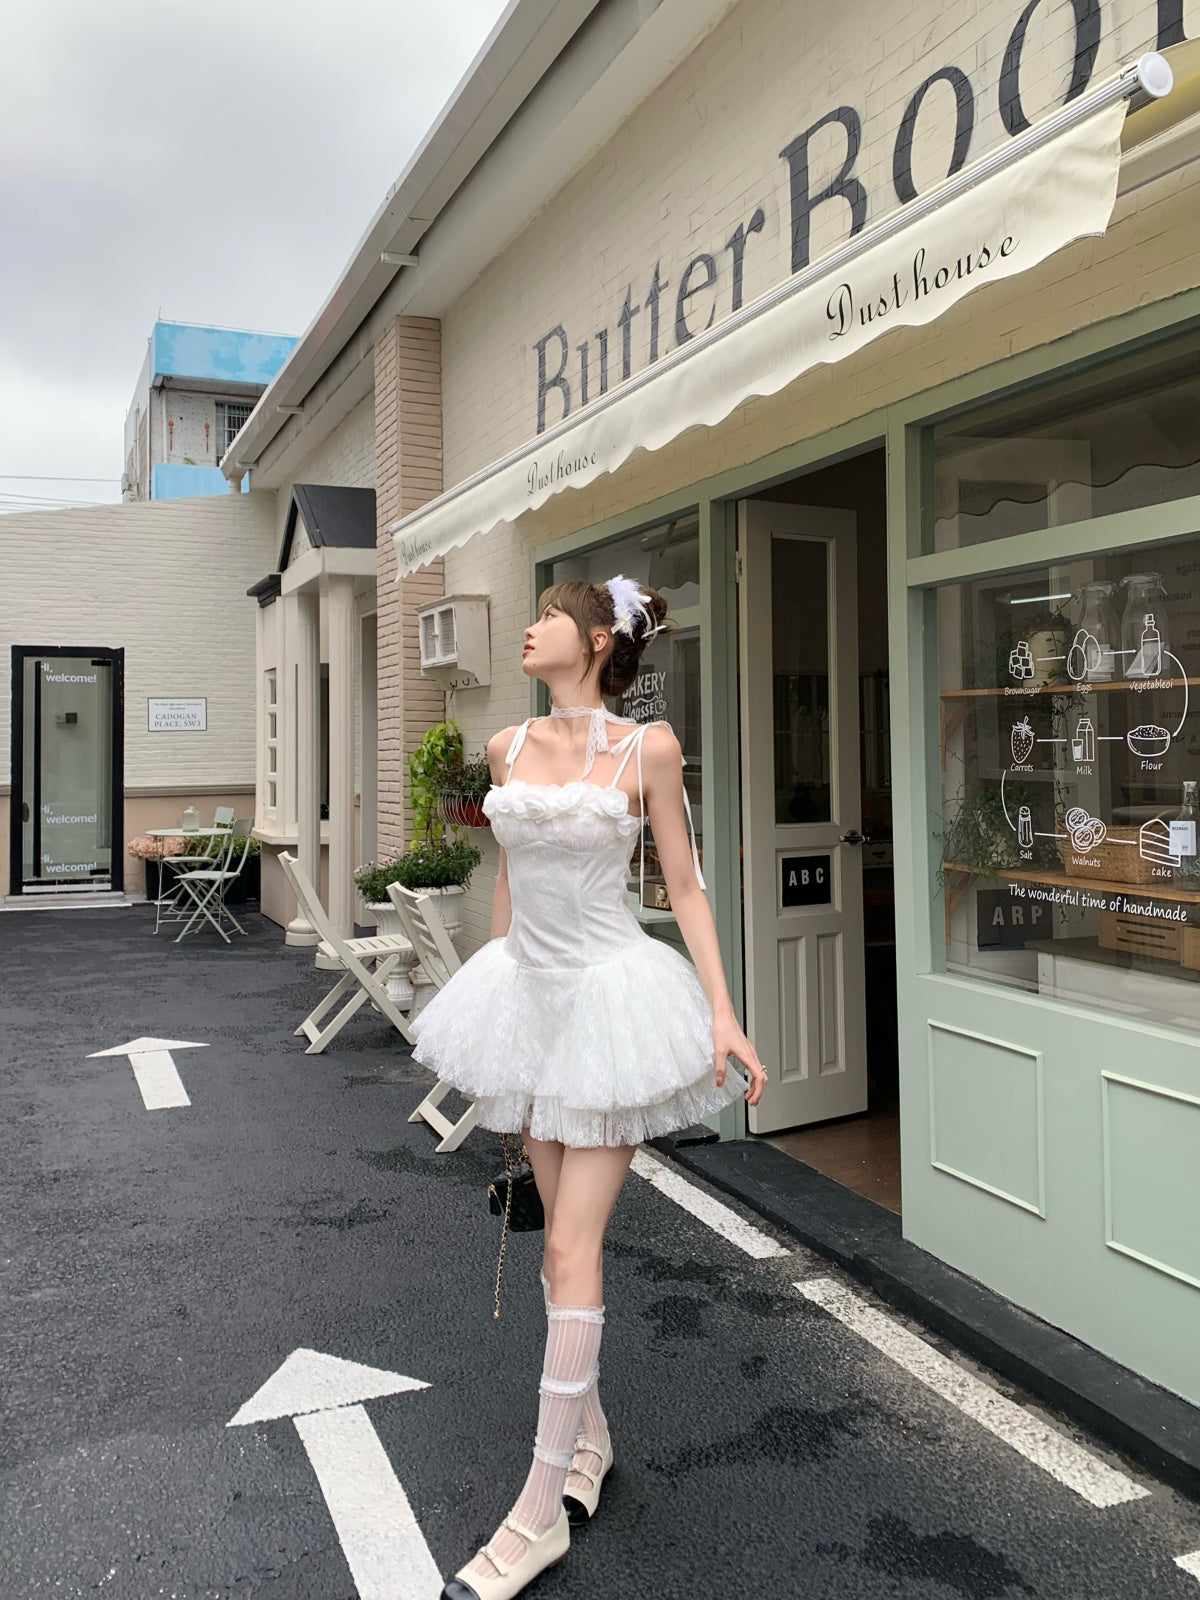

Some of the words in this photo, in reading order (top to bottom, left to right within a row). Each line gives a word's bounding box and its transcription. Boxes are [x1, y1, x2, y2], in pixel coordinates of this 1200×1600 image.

[532, 207, 766, 436] Butter
[778, 0, 1191, 276] Boo
[826, 236, 1020, 341] Dusthouse
[527, 449, 599, 496] Dusthouse
[46, 673, 97, 683] welcome!
[1004, 686, 1042, 697] Brownsugar
[1076, 683, 1093, 695] Eggs
[1010, 763, 1034, 773] Carrots
[1076, 766, 1093, 777] Milk
[1140, 760, 1164, 772] Flour
[46, 814, 97, 824] welcome!
[1020, 850, 1033, 861] Salt
[1071, 856, 1101, 868] Walnuts
[1151, 866, 1172, 878] cake
[1008, 883, 1026, 898] The
[1027, 888, 1079, 905] wonderful
[1081, 893, 1107, 910] time
[1109, 896, 1121, 912] of
[1122, 901, 1188, 922] handmade
